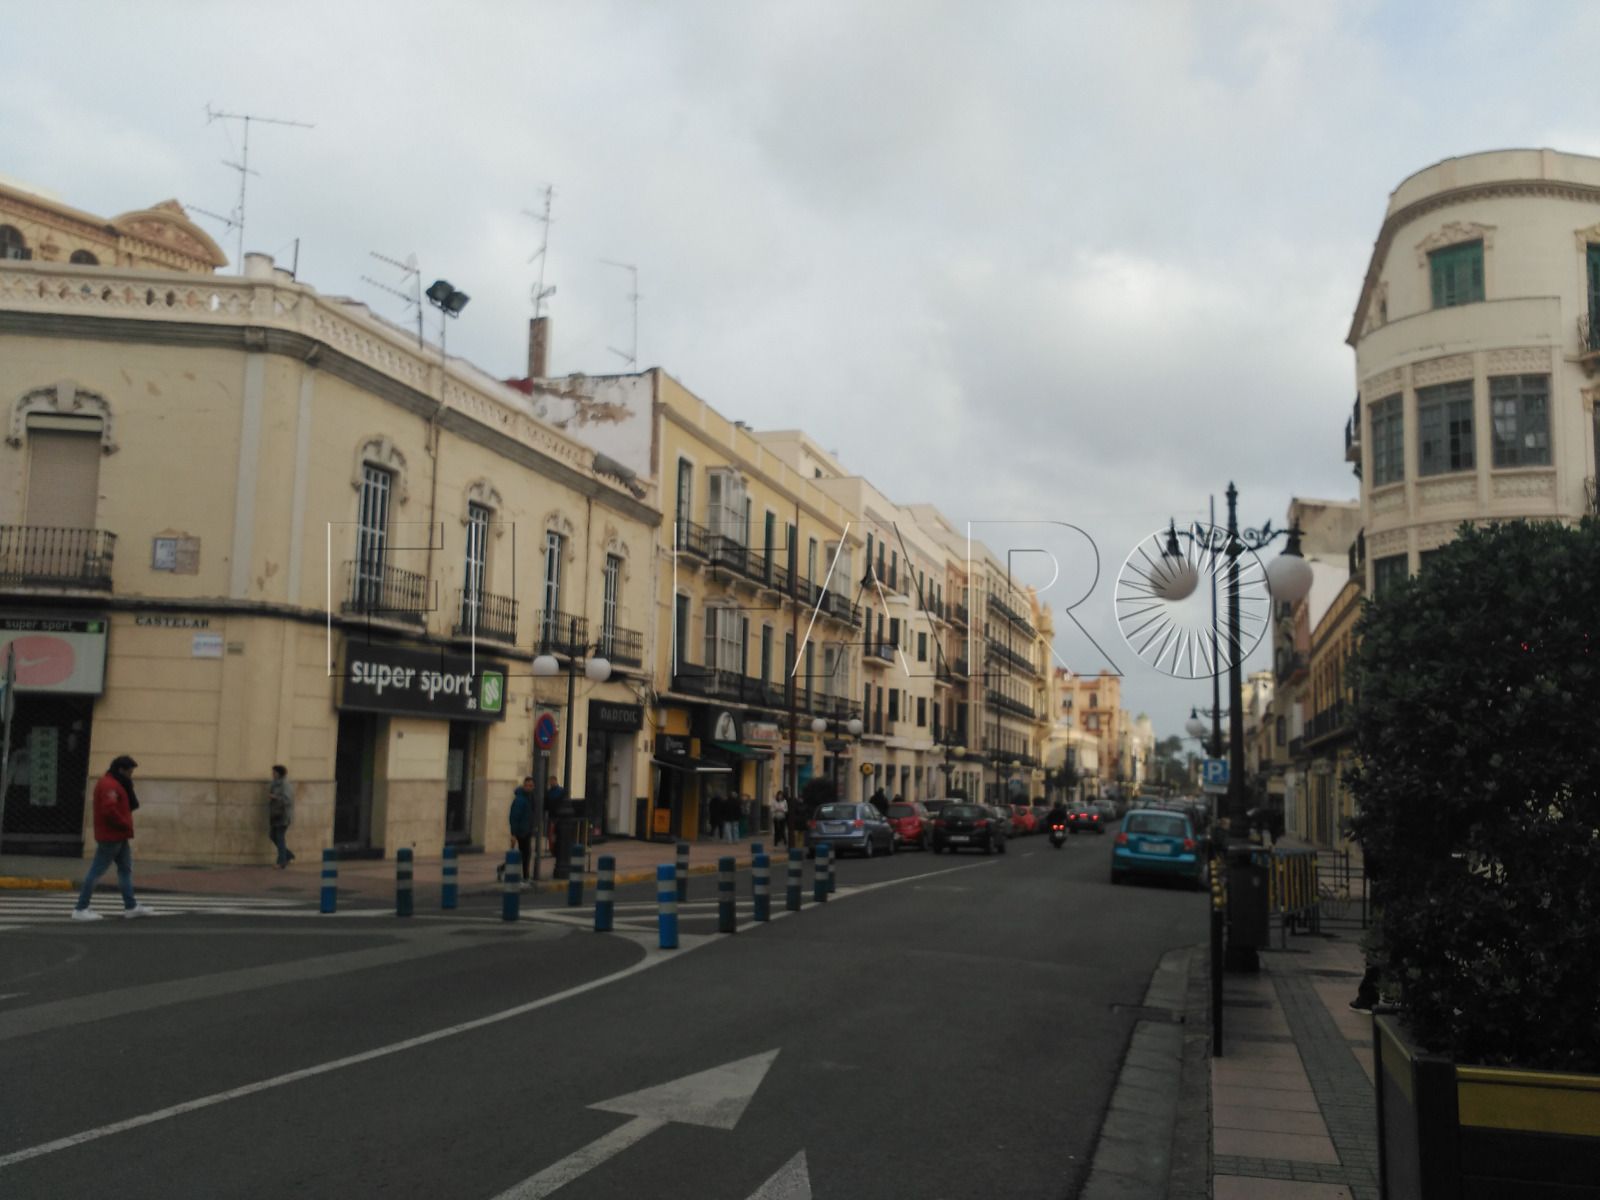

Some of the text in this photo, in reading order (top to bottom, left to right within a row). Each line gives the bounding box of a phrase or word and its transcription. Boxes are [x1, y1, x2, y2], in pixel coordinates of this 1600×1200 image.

[351, 660, 473, 700] super sport
[1208, 761, 1223, 782] P
